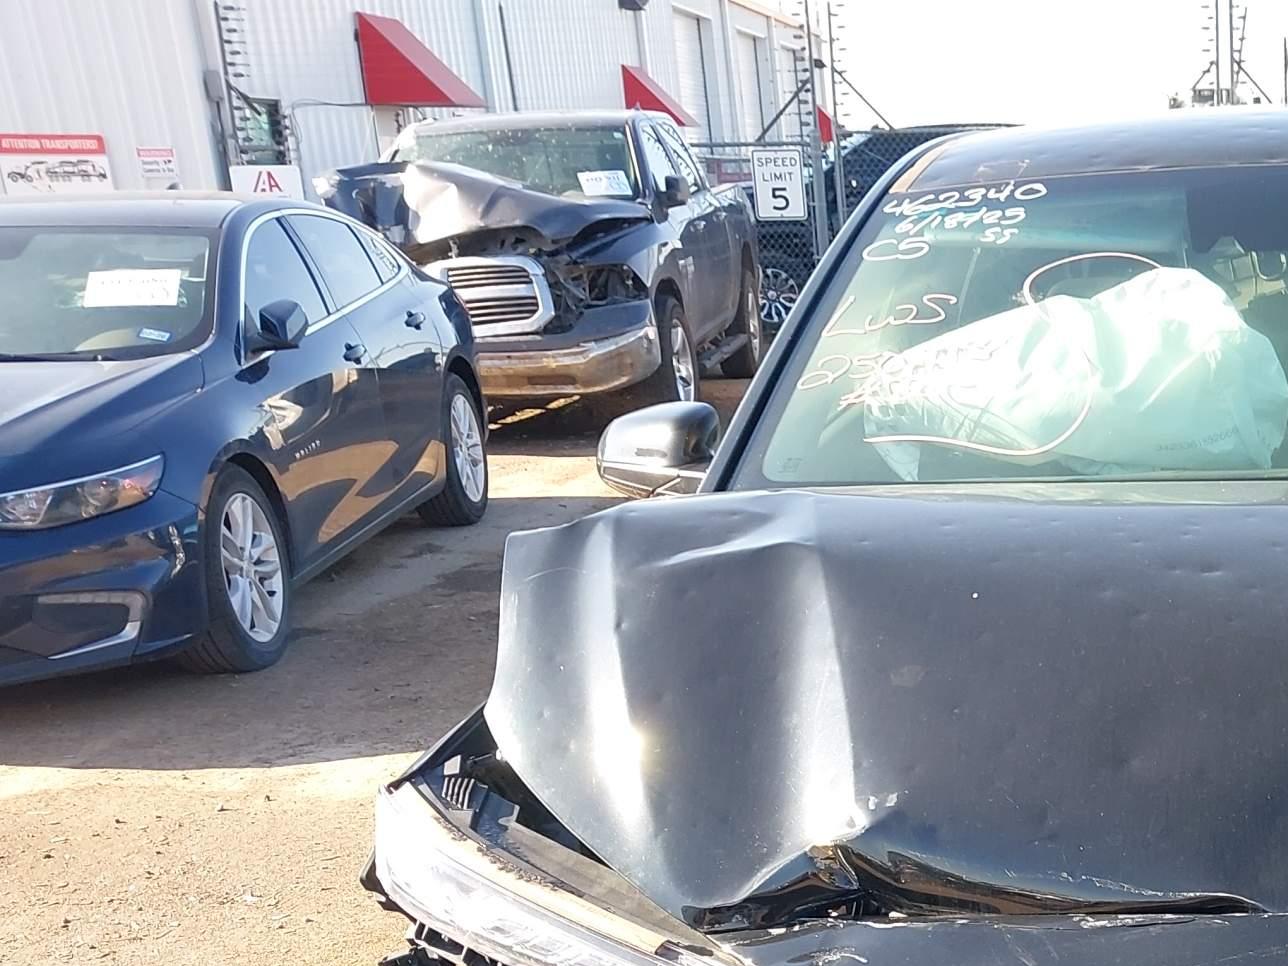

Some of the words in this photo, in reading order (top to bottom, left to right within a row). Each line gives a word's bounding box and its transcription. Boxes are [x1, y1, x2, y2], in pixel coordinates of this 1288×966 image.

[757, 157, 797, 167] SPEED
[762, 171, 793, 182] LIMIT
[772, 187, 790, 211] 5
[883, 180, 1047, 216] 462340
